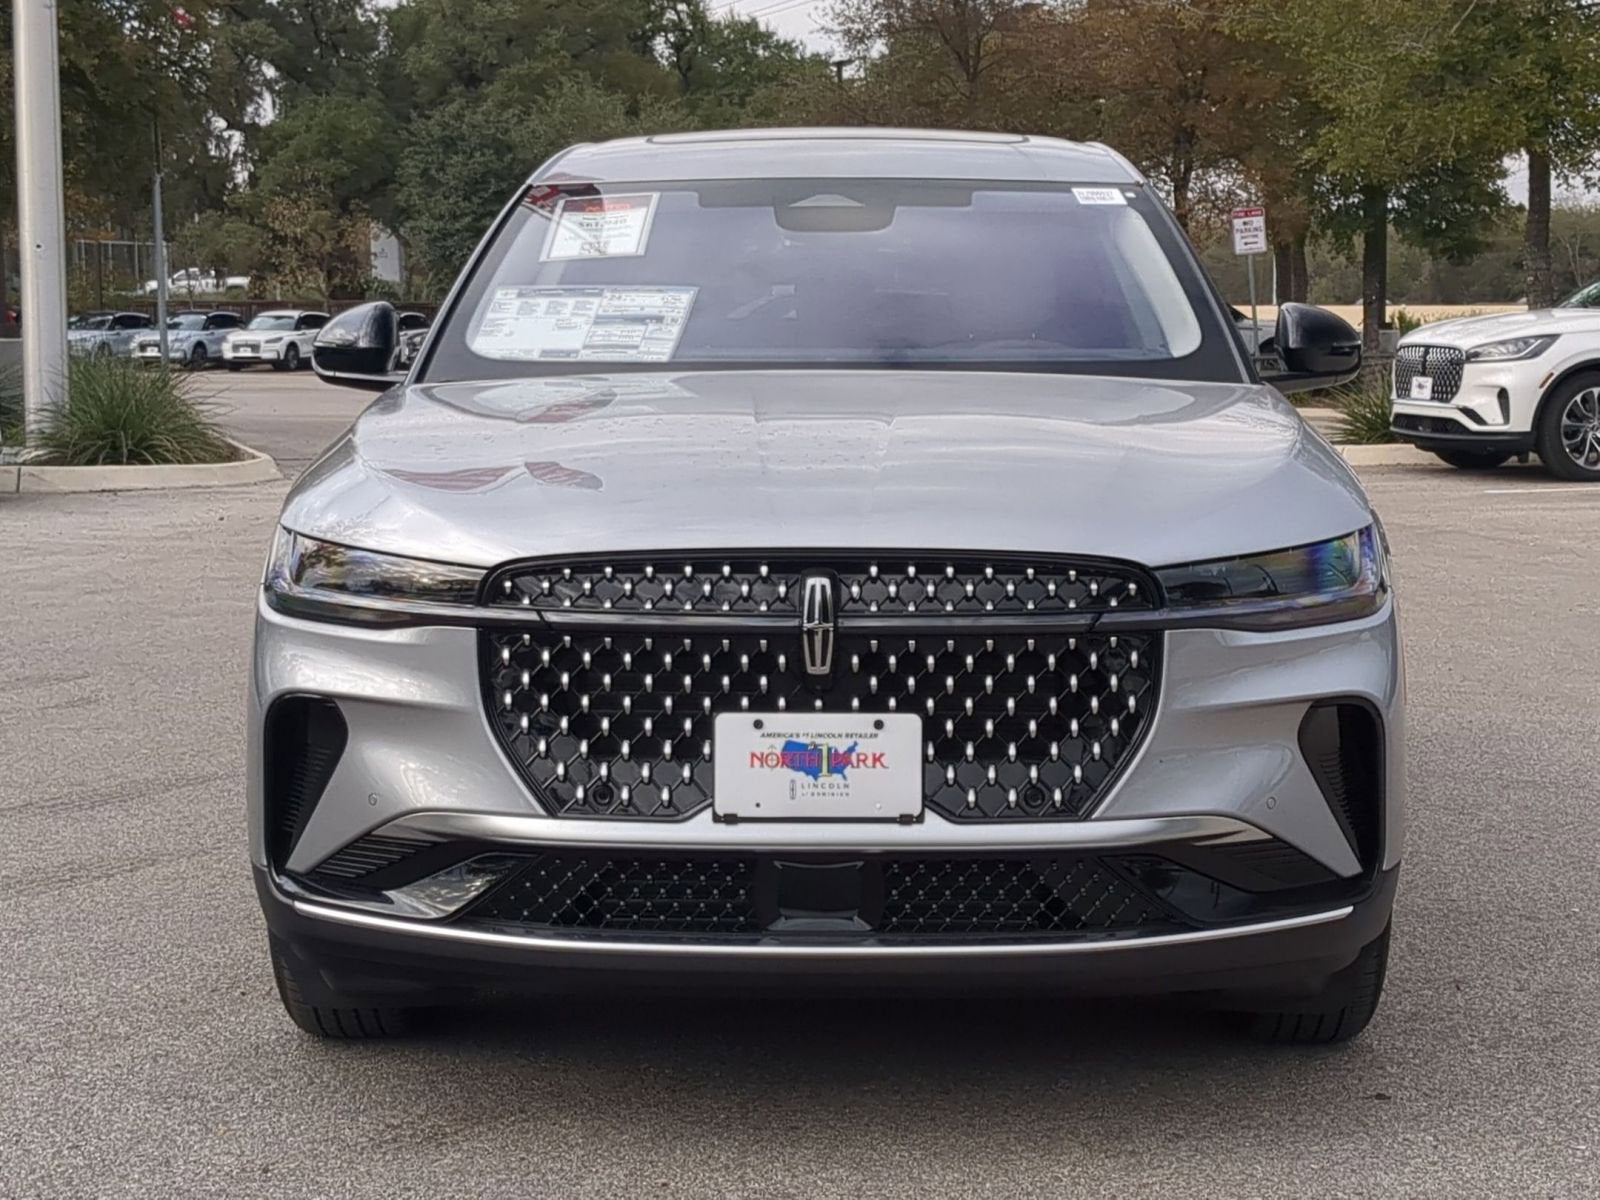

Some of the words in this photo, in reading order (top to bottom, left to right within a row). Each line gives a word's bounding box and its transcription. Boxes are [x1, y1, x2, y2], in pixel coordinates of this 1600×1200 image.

[1235, 226, 1264, 234] PARKING
[749, 751, 819, 769] NORTH
[831, 751, 889, 769] PARK
